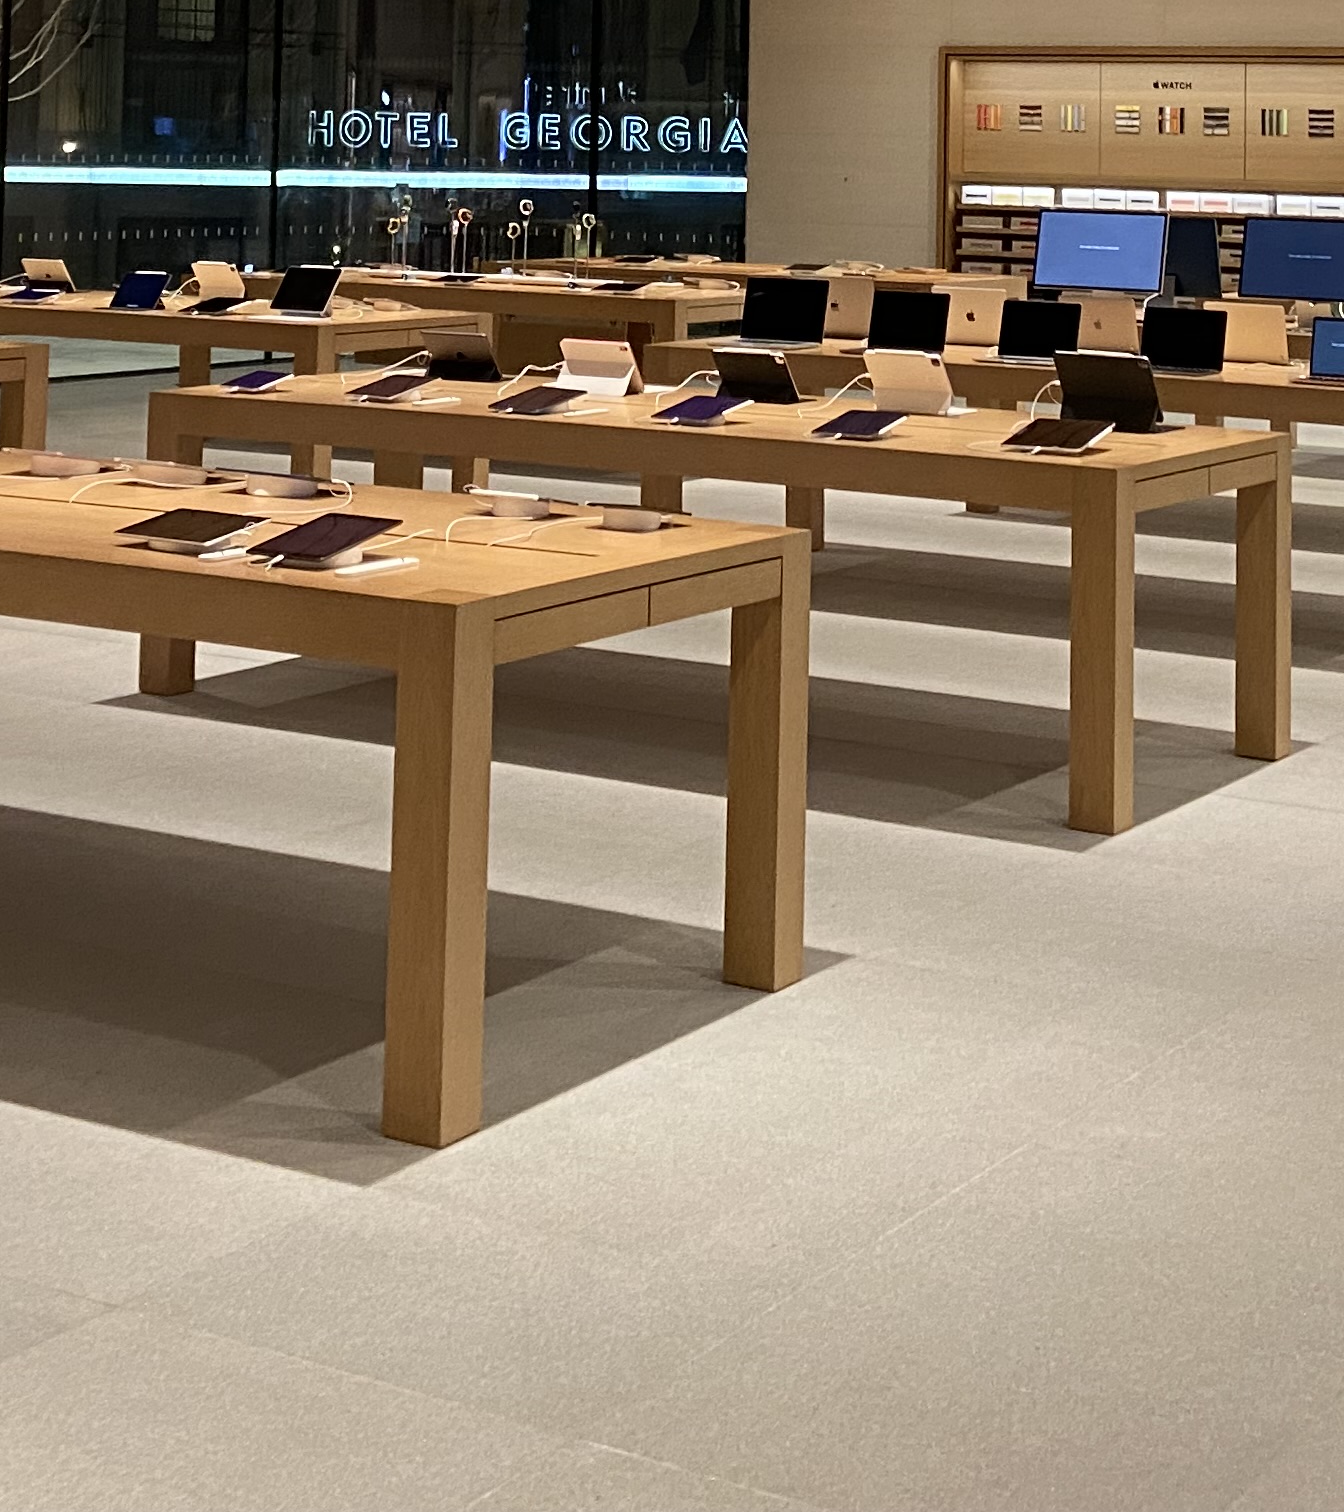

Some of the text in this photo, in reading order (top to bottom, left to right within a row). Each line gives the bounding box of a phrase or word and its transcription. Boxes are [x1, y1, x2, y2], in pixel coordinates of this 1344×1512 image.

[1161, 81, 1192, 90] WATCH
[308, 109, 748, 153] HOTEL GEORGIA
